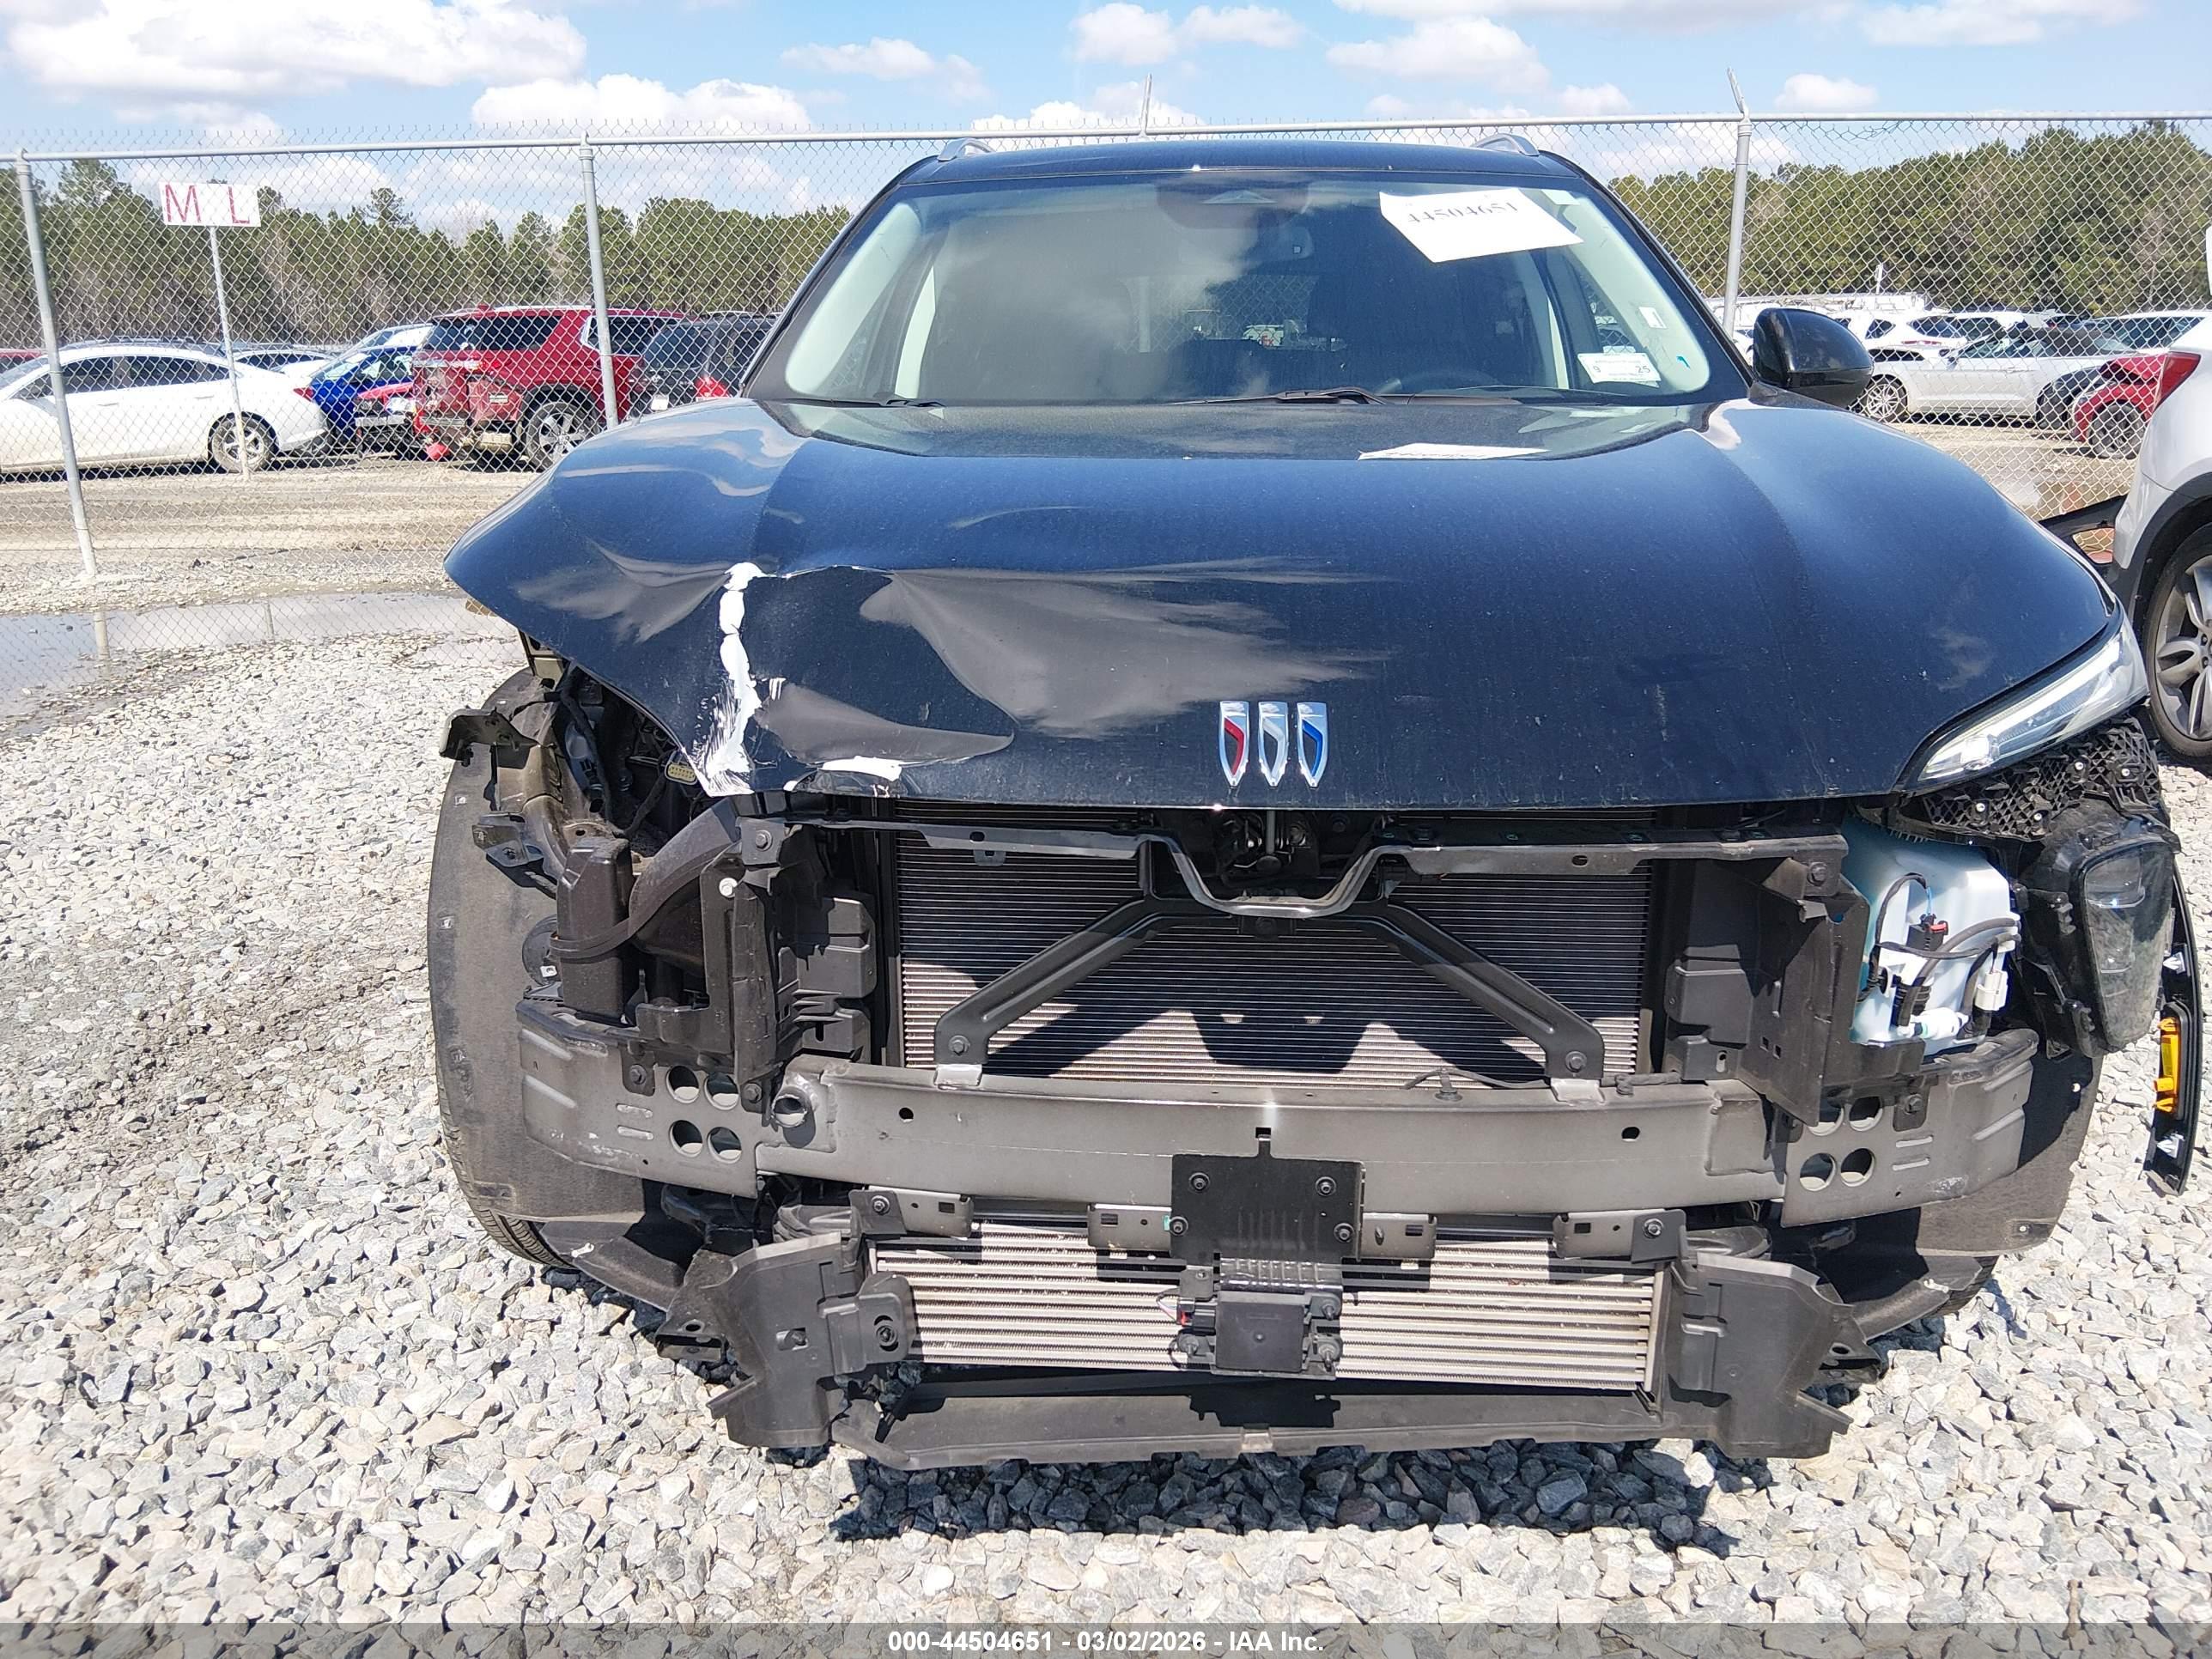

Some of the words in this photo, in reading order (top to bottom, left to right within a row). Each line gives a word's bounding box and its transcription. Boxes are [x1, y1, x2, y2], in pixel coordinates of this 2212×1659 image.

[165, 184, 202, 223] M
[228, 185, 250, 224] L
[1635, 365, 1651, 374] 25
